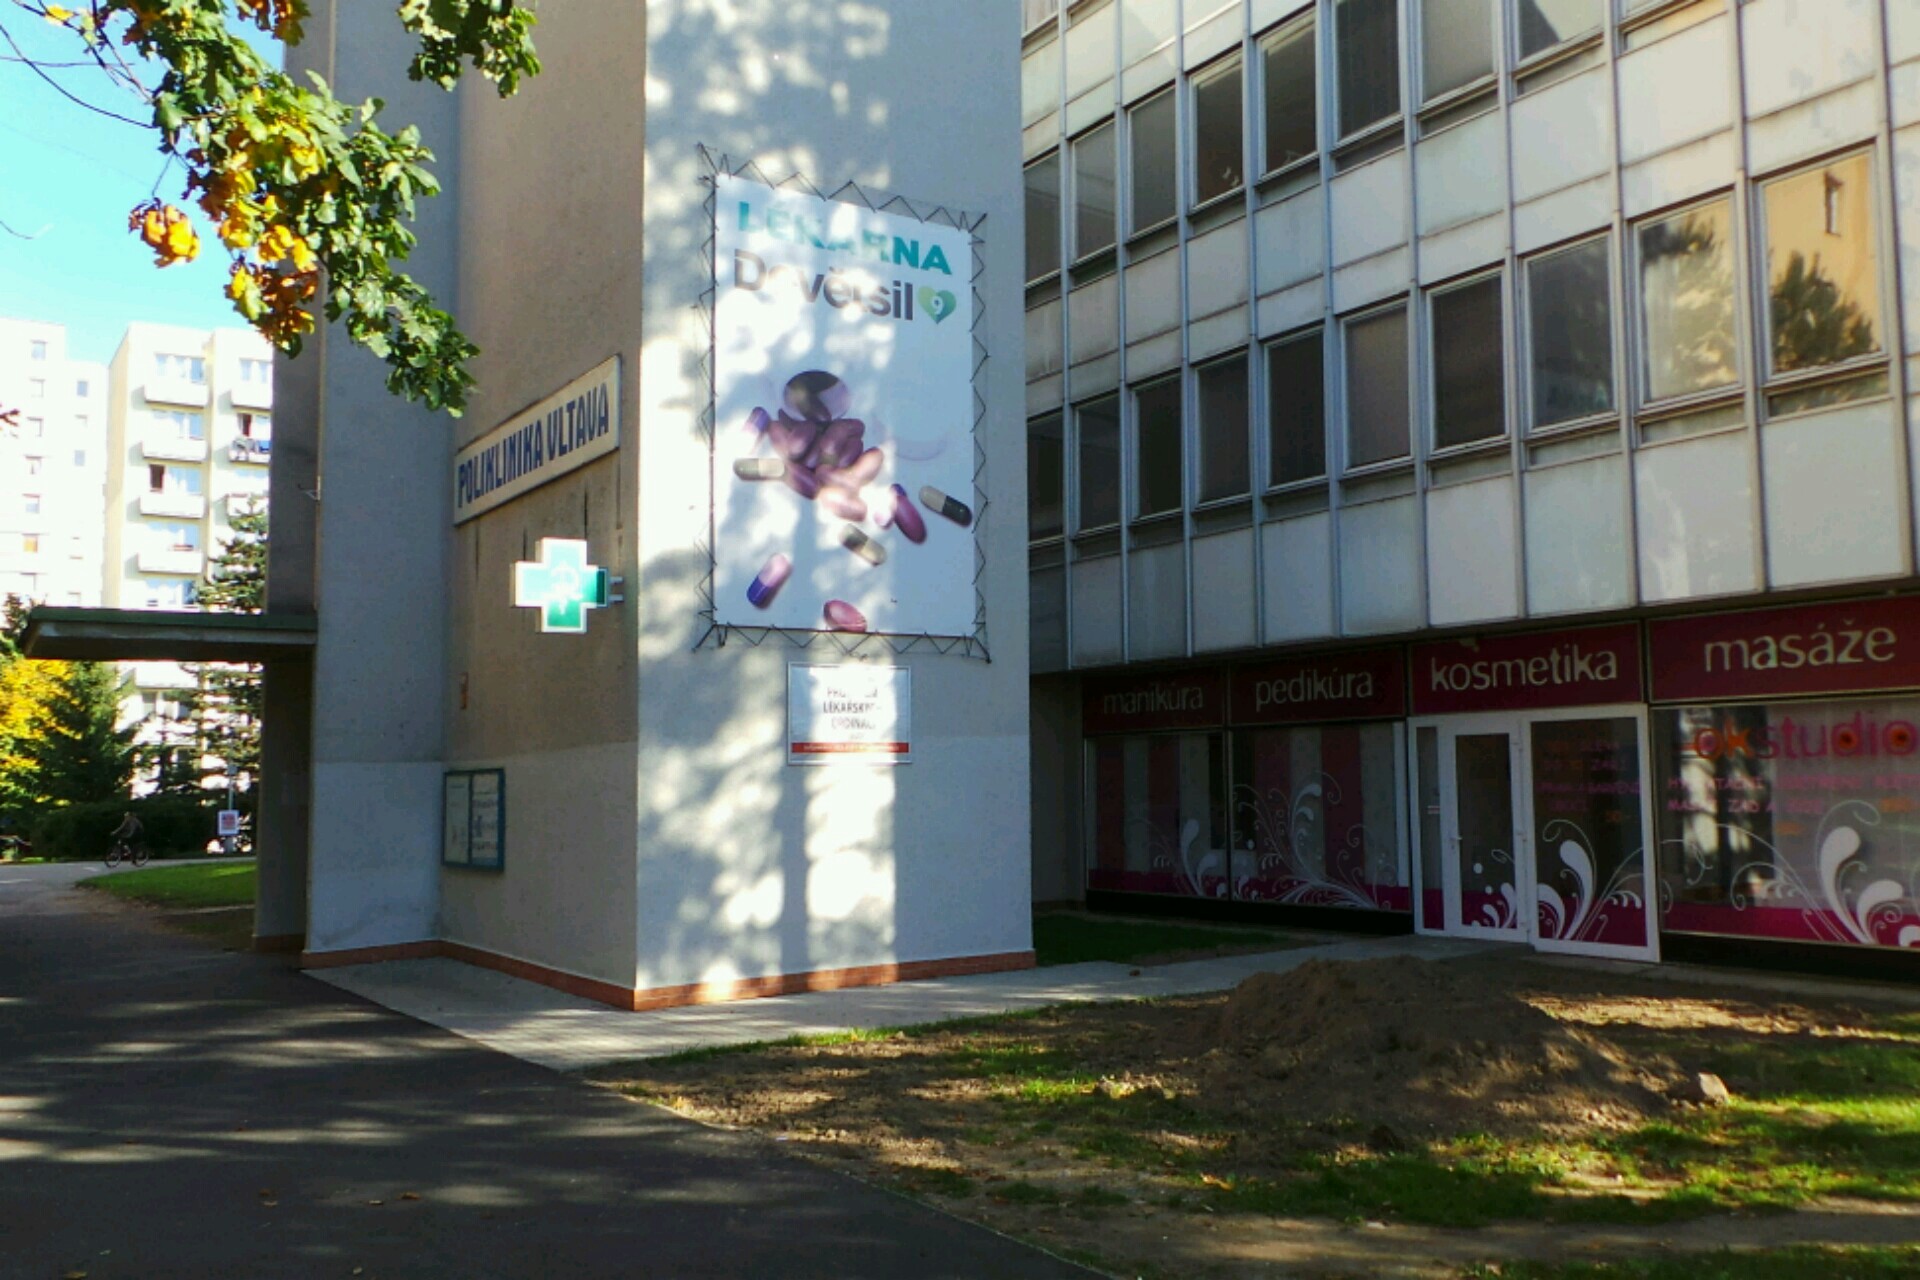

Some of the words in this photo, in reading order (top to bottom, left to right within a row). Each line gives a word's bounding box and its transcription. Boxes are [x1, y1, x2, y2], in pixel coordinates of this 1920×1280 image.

[458, 420, 544, 508] POLIKLINIKA
[547, 383, 609, 461] VLTAVA
[1255, 667, 1374, 712] pedikúra
[1431, 643, 1618, 692] kosmetika
[1704, 619, 1898, 672] masáže
